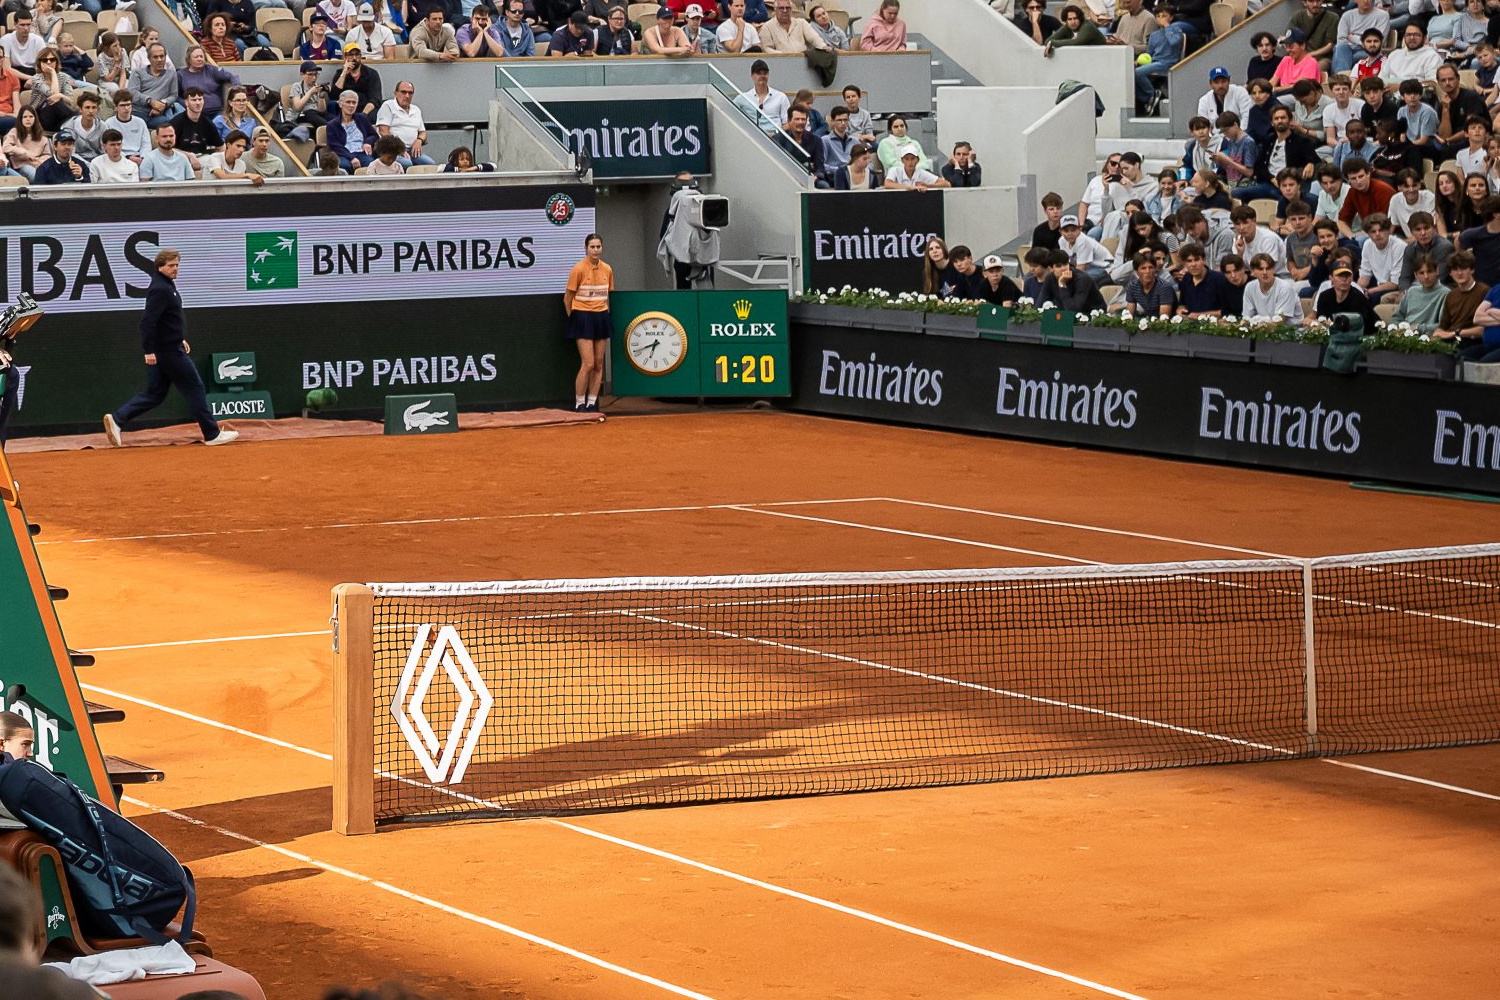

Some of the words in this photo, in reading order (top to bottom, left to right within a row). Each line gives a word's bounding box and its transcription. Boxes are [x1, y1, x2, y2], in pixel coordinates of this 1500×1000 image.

[542, 118, 701, 158] mirates
[312, 242, 383, 276] BNP
[394, 237, 536, 272] PARIBAS
[710, 323, 777, 337] ROLEX
[302, 360, 364, 390] BNP
[373, 353, 497, 386] PARIBAS
[715, 355, 775, 383] 1:20
[819, 349, 943, 407] Emirates
[211, 398, 266, 417] LACOSTE
[996, 366, 1138, 430] Emirates
[1200, 386, 1361, 454] Emirates
